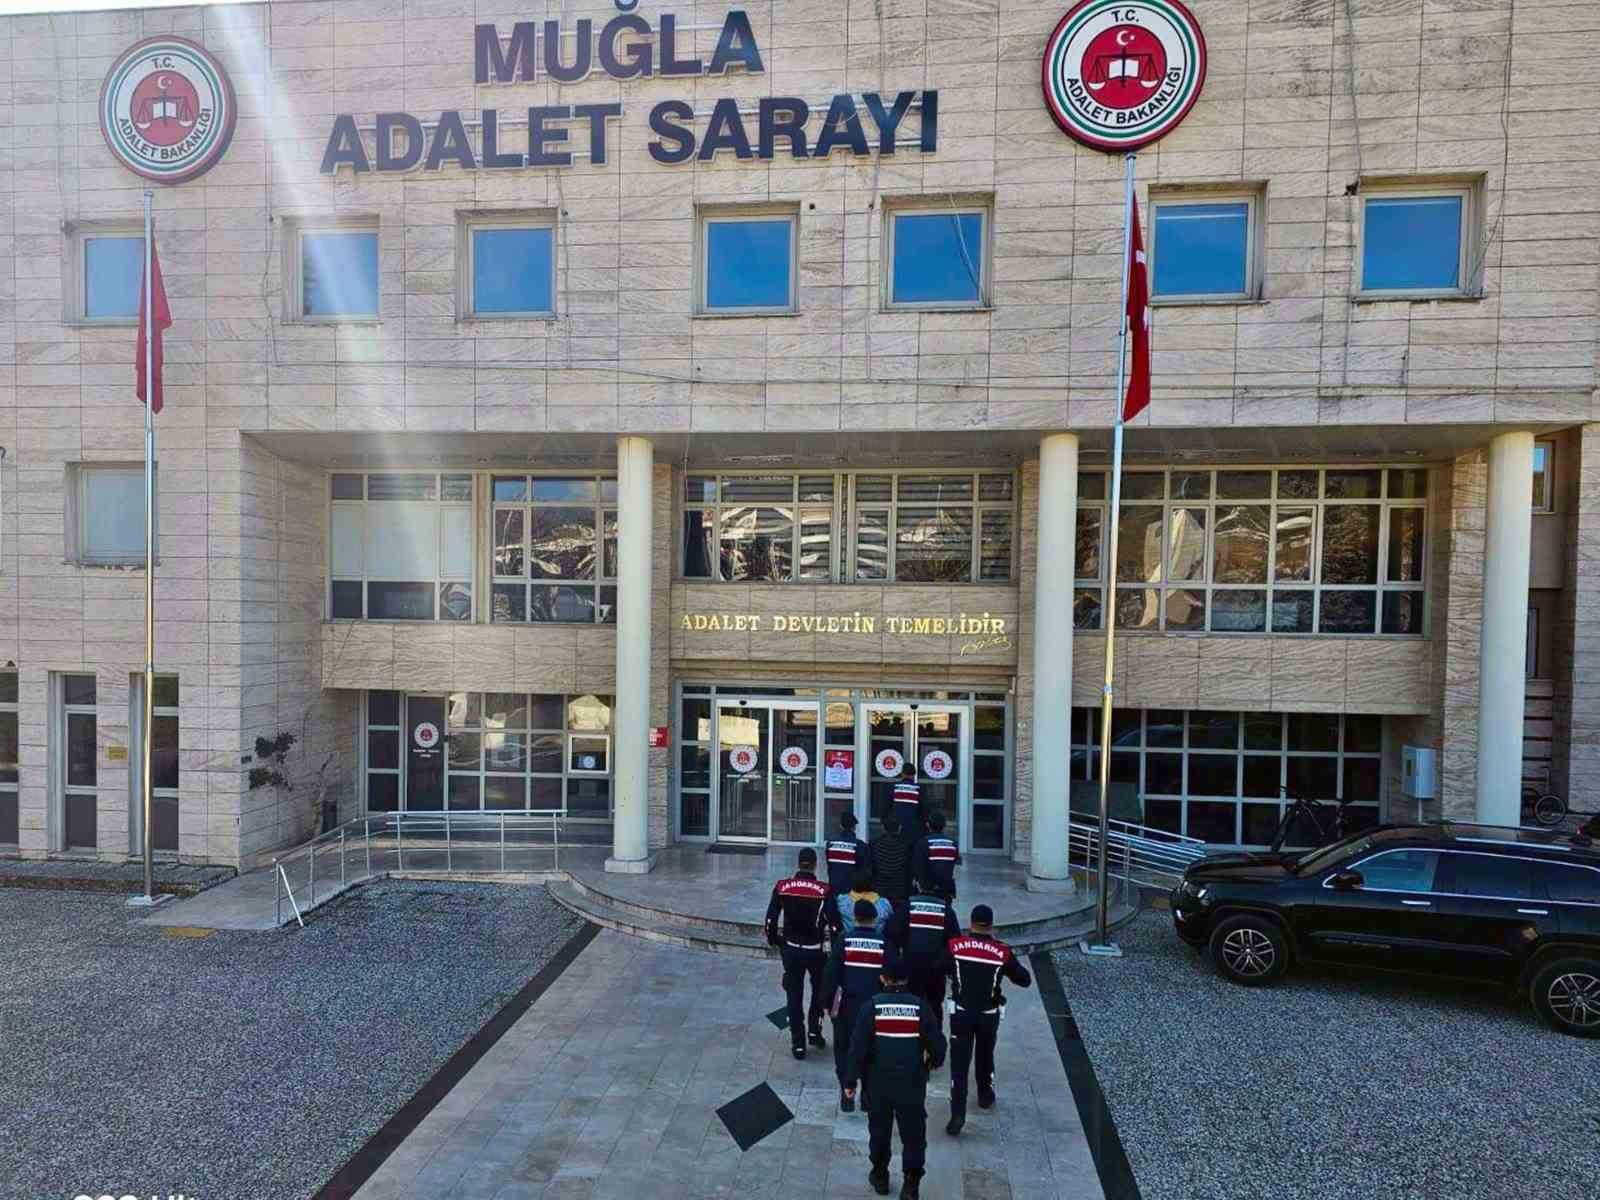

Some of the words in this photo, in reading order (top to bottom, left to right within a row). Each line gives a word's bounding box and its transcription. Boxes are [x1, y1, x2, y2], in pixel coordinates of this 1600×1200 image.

[1112, 9, 1139, 22] T.C.
[474, 0, 765, 85] MUĞLA
[151, 57, 176, 69] T.C.
[1067, 77, 1113, 122] ADALET
[120, 118, 158, 158] ADALET
[320, 103, 623, 175] ADALET
[648, 90, 939, 165] SARAYI
[681, 614, 760, 631] ADALET
[773, 611, 875, 633] DEVLETİN
[887, 612, 1005, 634] TEMELİDİR
[781, 880, 825, 895] JANDARMA
[953, 939, 1004, 958] JANDARMA
[880, 1006, 917, 1017] JANDARMA
